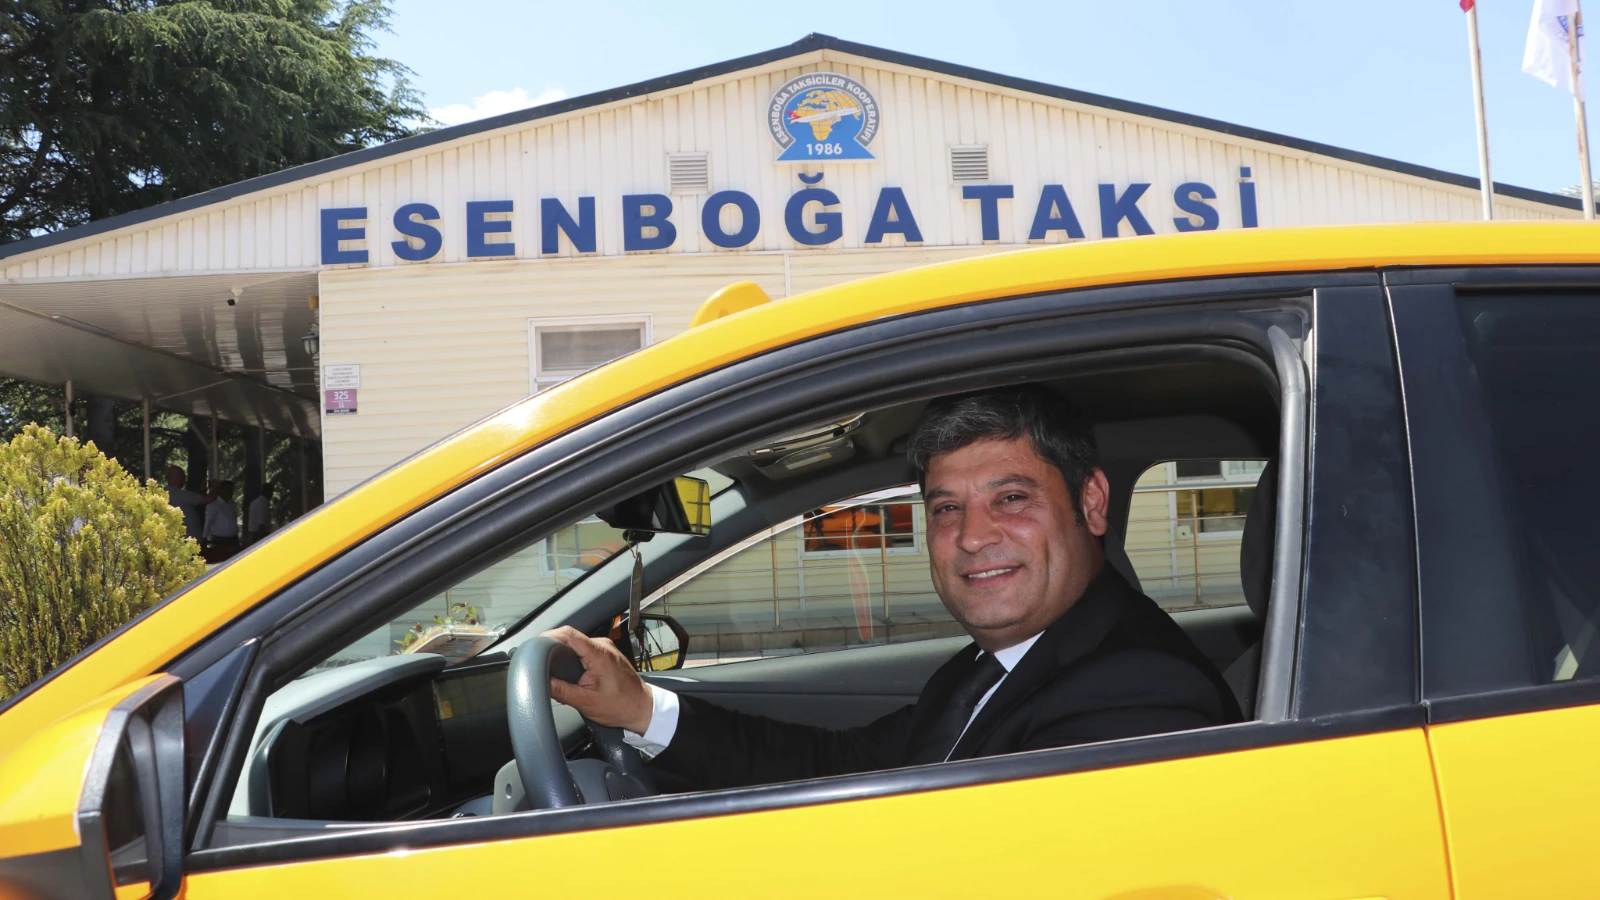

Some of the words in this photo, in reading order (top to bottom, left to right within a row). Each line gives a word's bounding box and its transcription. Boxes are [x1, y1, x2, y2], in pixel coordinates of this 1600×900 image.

[771, 92, 790, 144] ESENBOĞA
[787, 74, 846, 94] TAKSİCİLER
[806, 143, 843, 155] 1986
[320, 172, 925, 265] ESENBOĞA
[962, 166, 1259, 241] TAKSİ
[333, 391, 349, 401] 325
